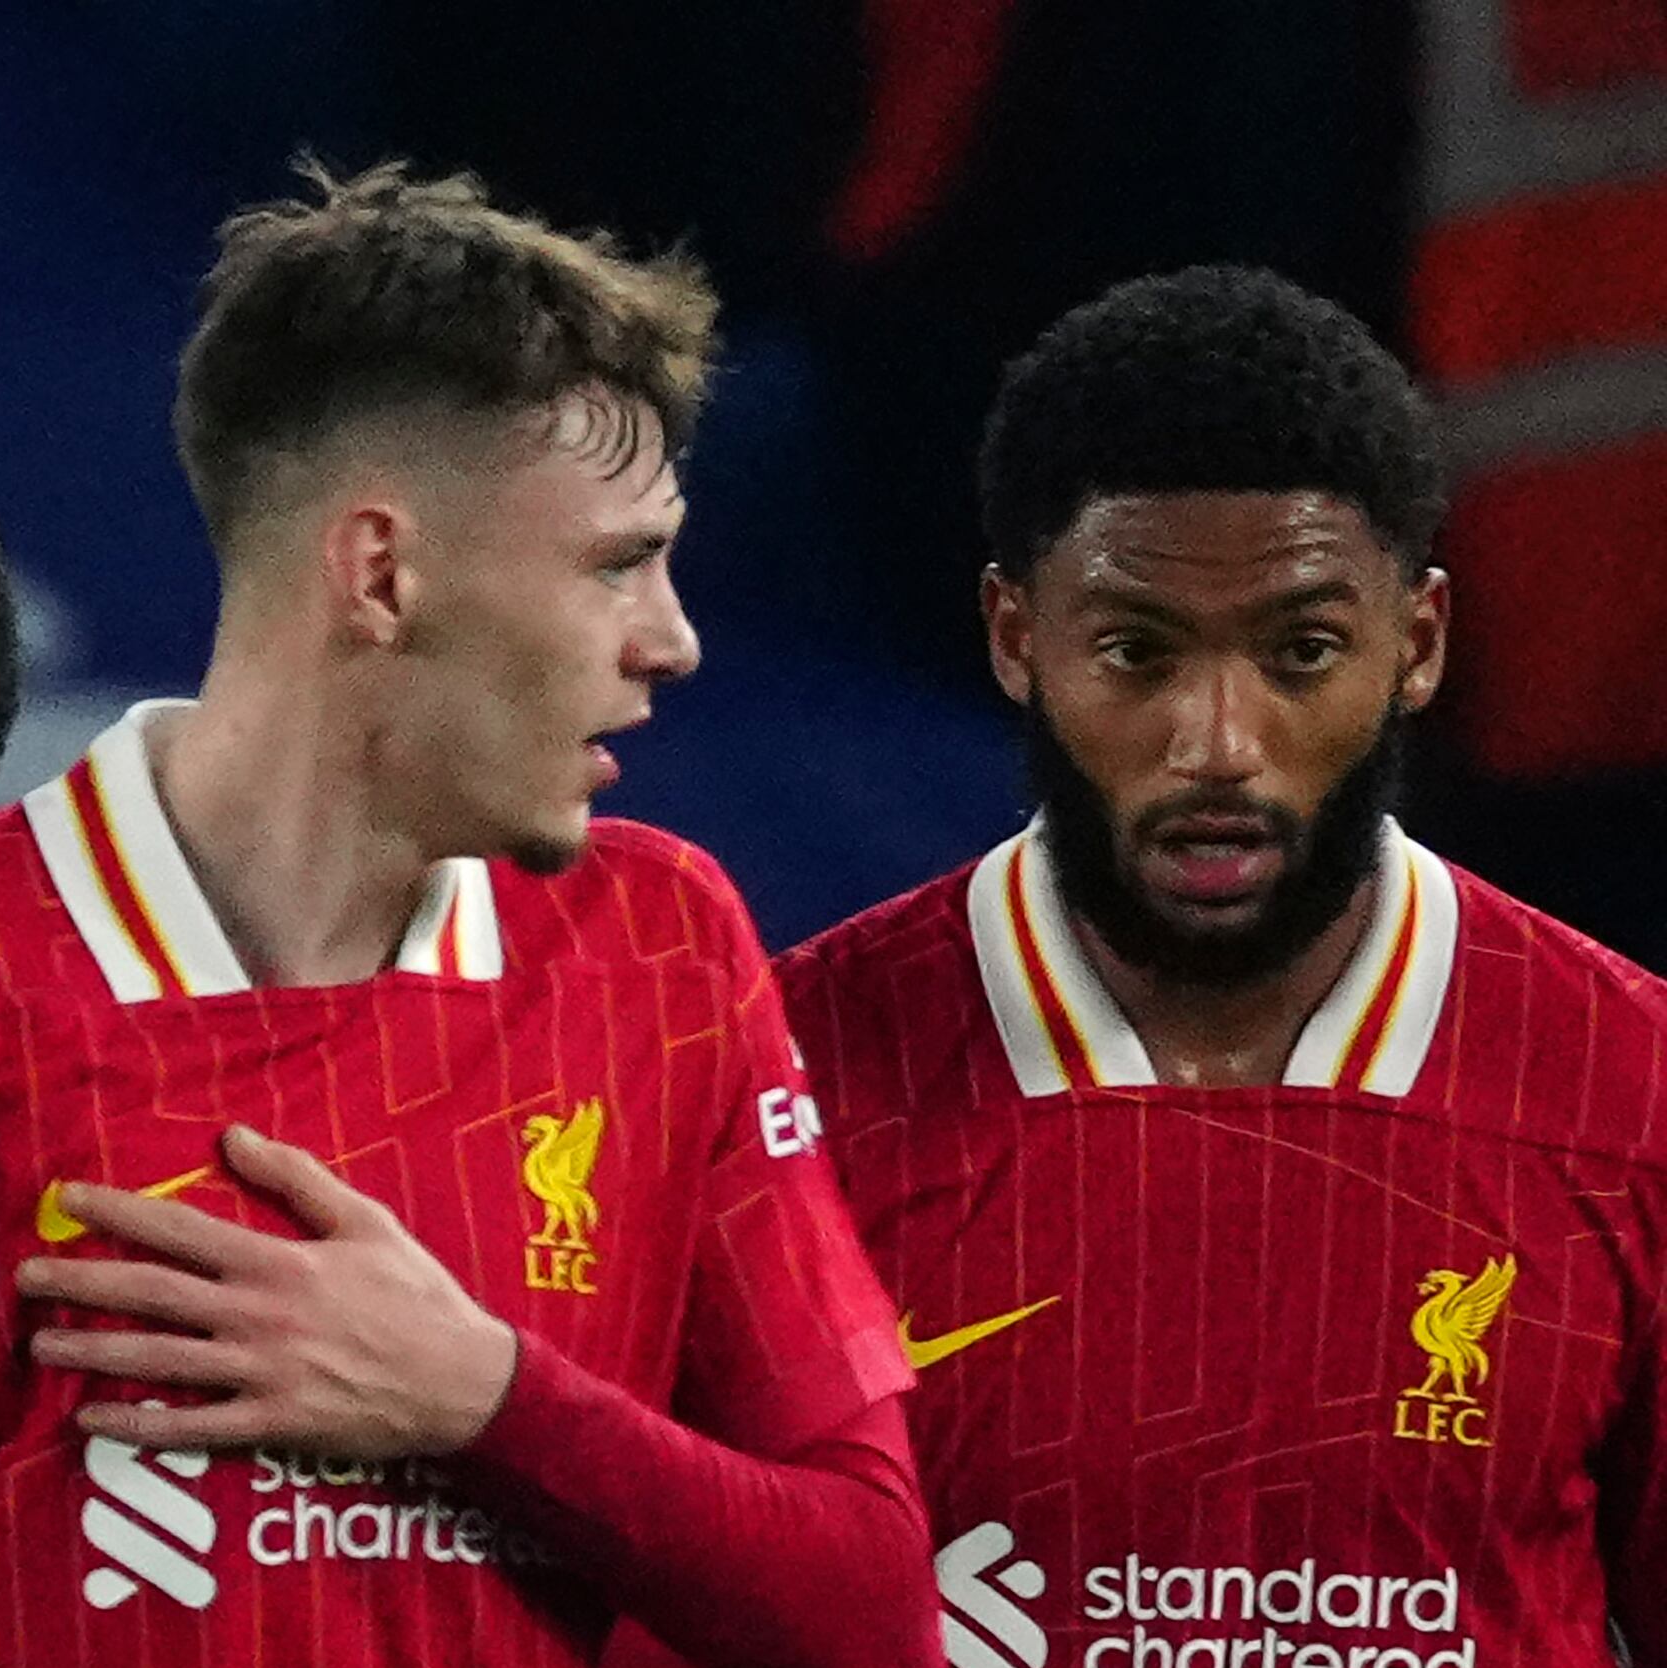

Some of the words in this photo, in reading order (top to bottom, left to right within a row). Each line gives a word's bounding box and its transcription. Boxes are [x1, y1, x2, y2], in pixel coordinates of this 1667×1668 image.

[525, 1246, 600, 1295] LFC
[1393, 1399, 1496, 1447] LFC
[1084, 1553, 1458, 1633] standard
